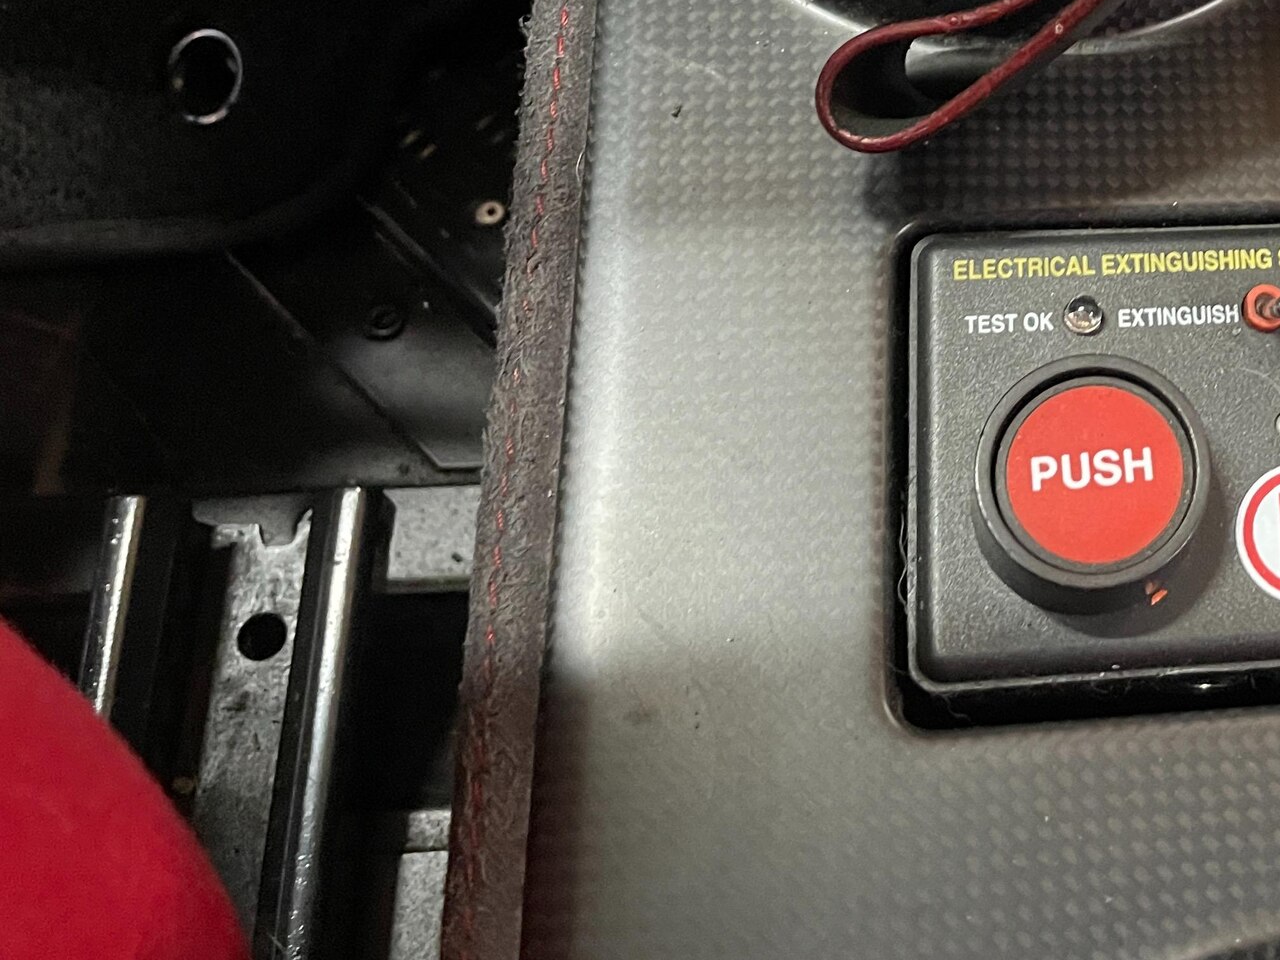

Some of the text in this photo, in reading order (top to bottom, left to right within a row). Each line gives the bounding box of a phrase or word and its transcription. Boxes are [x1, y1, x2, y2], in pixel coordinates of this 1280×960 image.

[953, 255, 1096, 281] ELECTRICAL
[1101, 247, 1273, 276] EXTINGUISHING
[964, 311, 1054, 334] TEST OK
[1118, 304, 1240, 328] EXTINGUISH
[1030, 446, 1154, 492] PUSH
